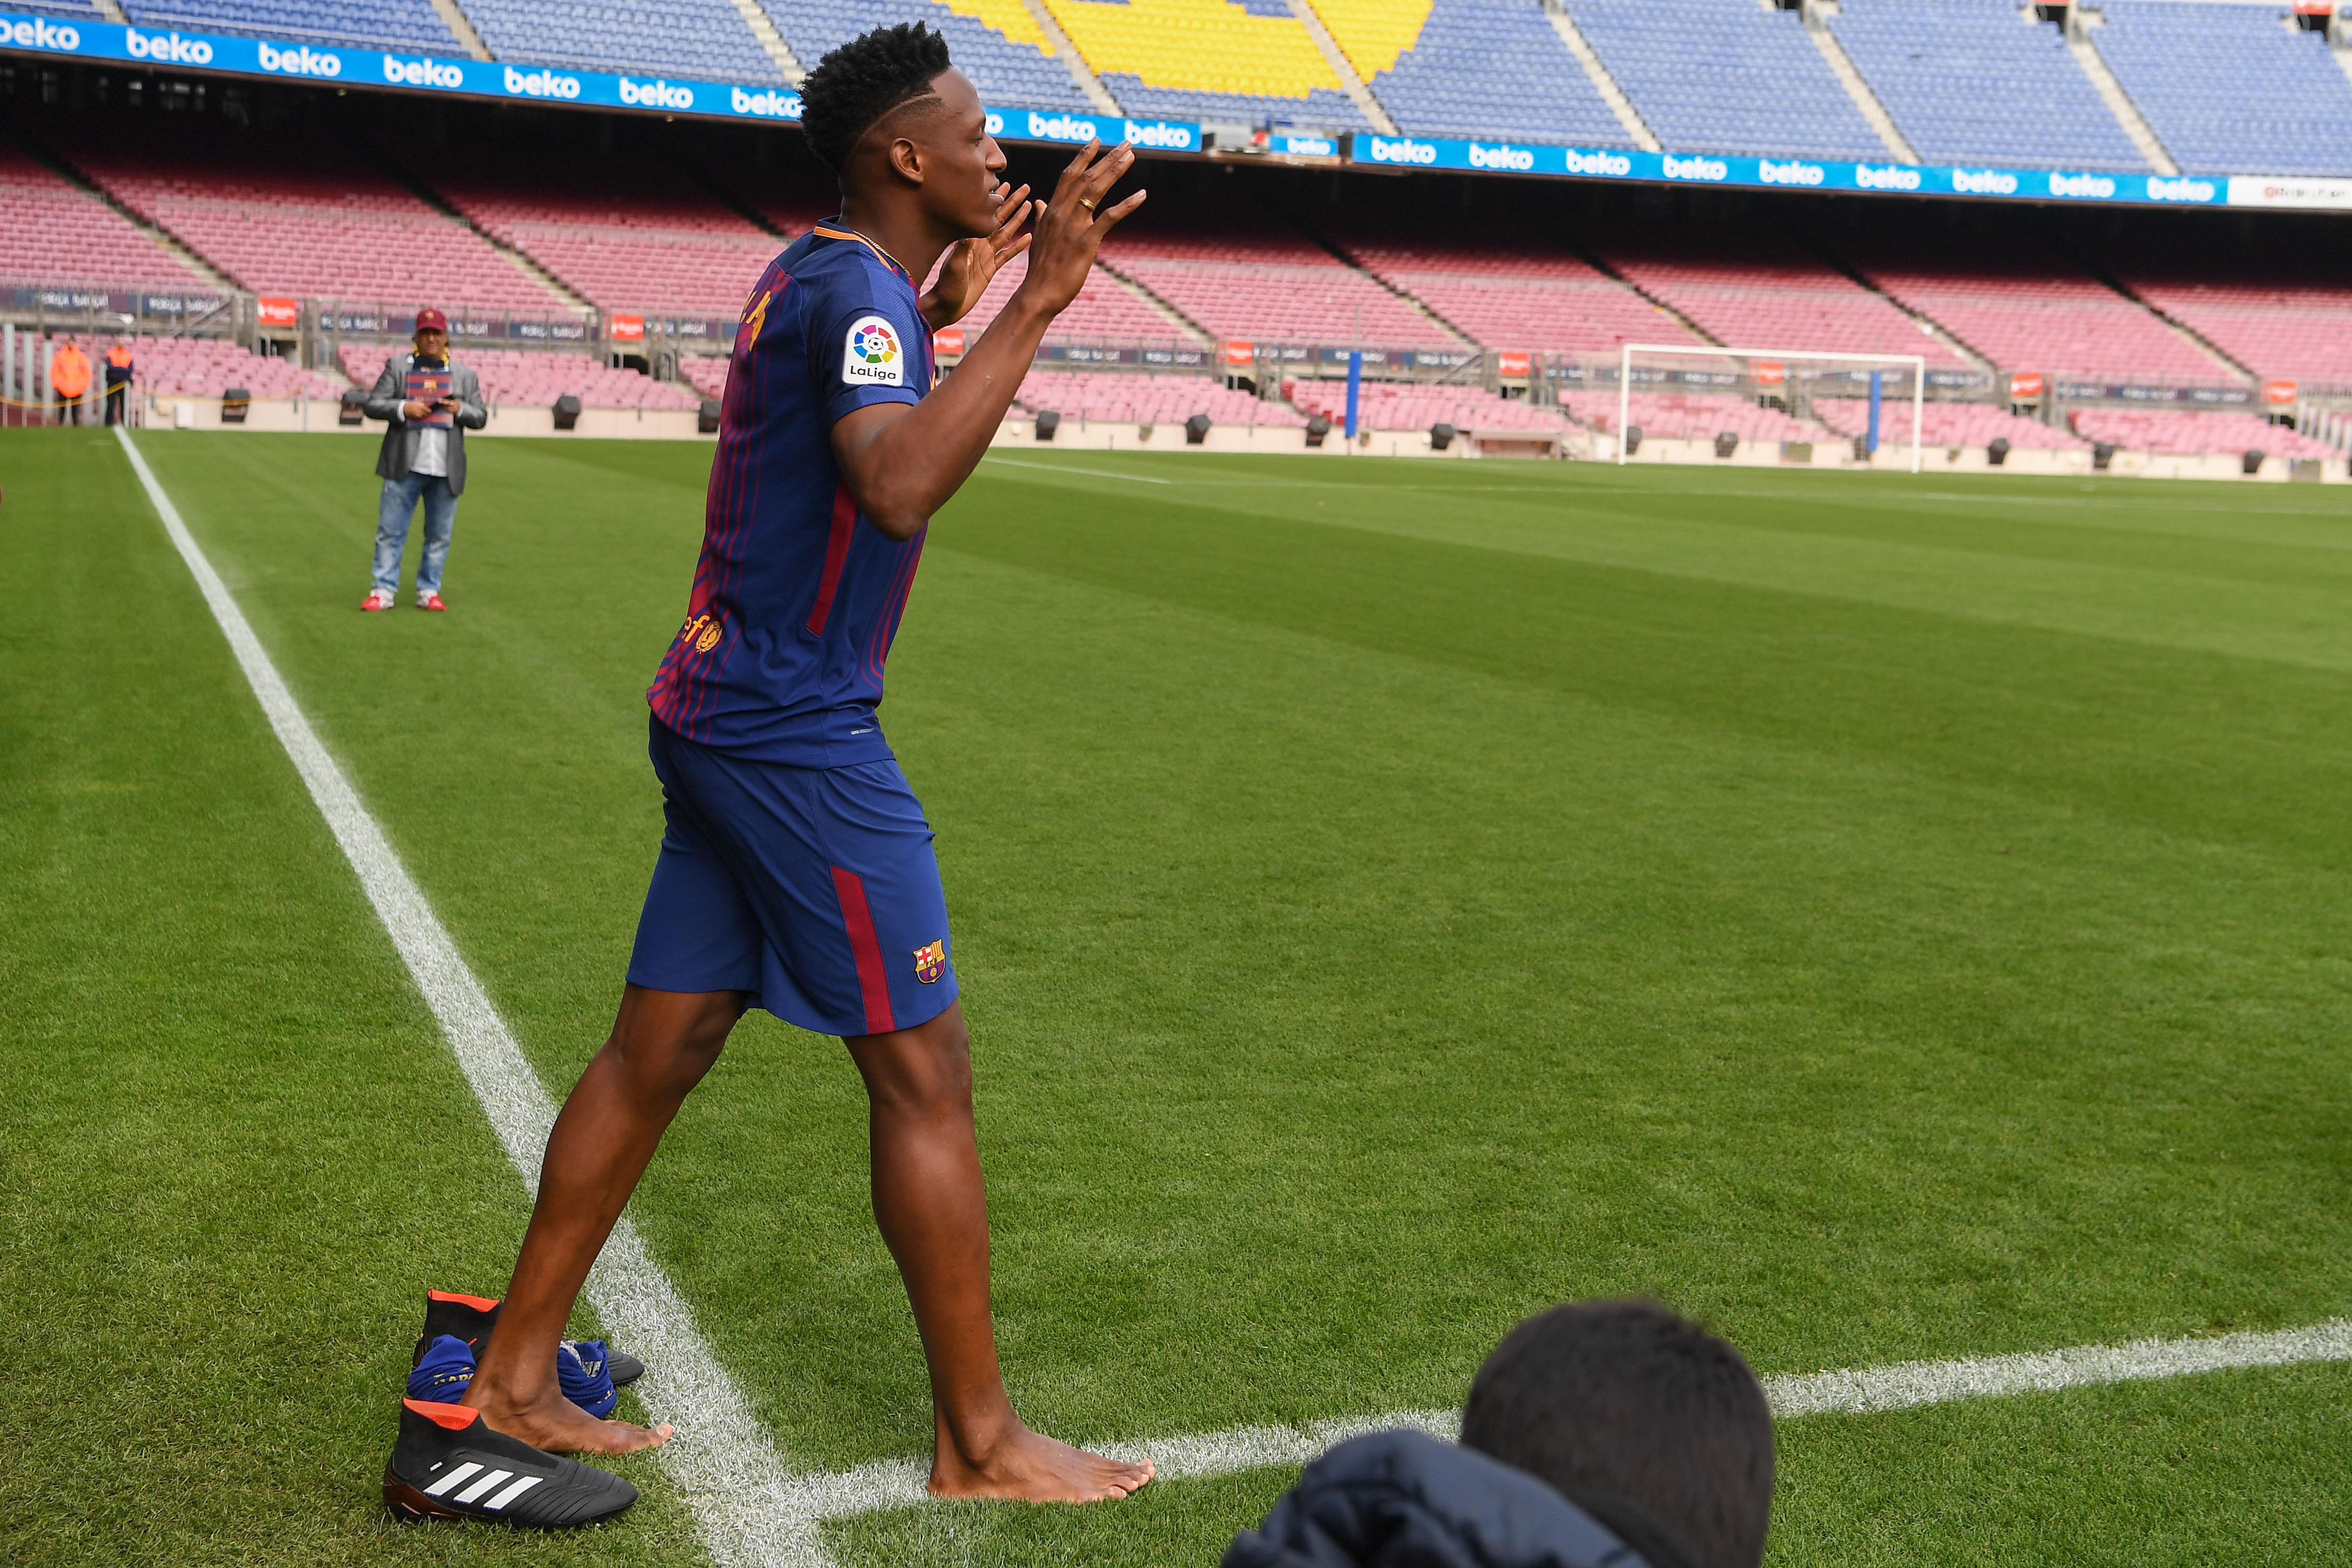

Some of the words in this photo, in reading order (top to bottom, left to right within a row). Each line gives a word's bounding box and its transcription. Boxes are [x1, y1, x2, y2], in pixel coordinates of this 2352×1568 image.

[126, 28, 213, 64] beko
[259, 42, 341, 76] beko
[384, 54, 463, 88] beko
[504, 66, 581, 98] beko
[619, 77, 694, 109] beko
[732, 87, 801, 118] beko
[1028, 112, 1097, 143] beko
[1124, 120, 1191, 147] beko
[1287, 137, 1330, 155] beko
[1371, 137, 1436, 164] beko
[1469, 143, 1534, 170] beko
[1566, 148, 1631, 176] beko
[1663, 154, 1727, 180] beko
[1759, 159, 1824, 185] beko
[1855, 164, 1921, 190] beko
[1952, 168, 2017, 194] beko
[2049, 172, 2115, 198] beko
[2147, 176, 2215, 202] beko
[850, 365, 896, 380] LaLiga
